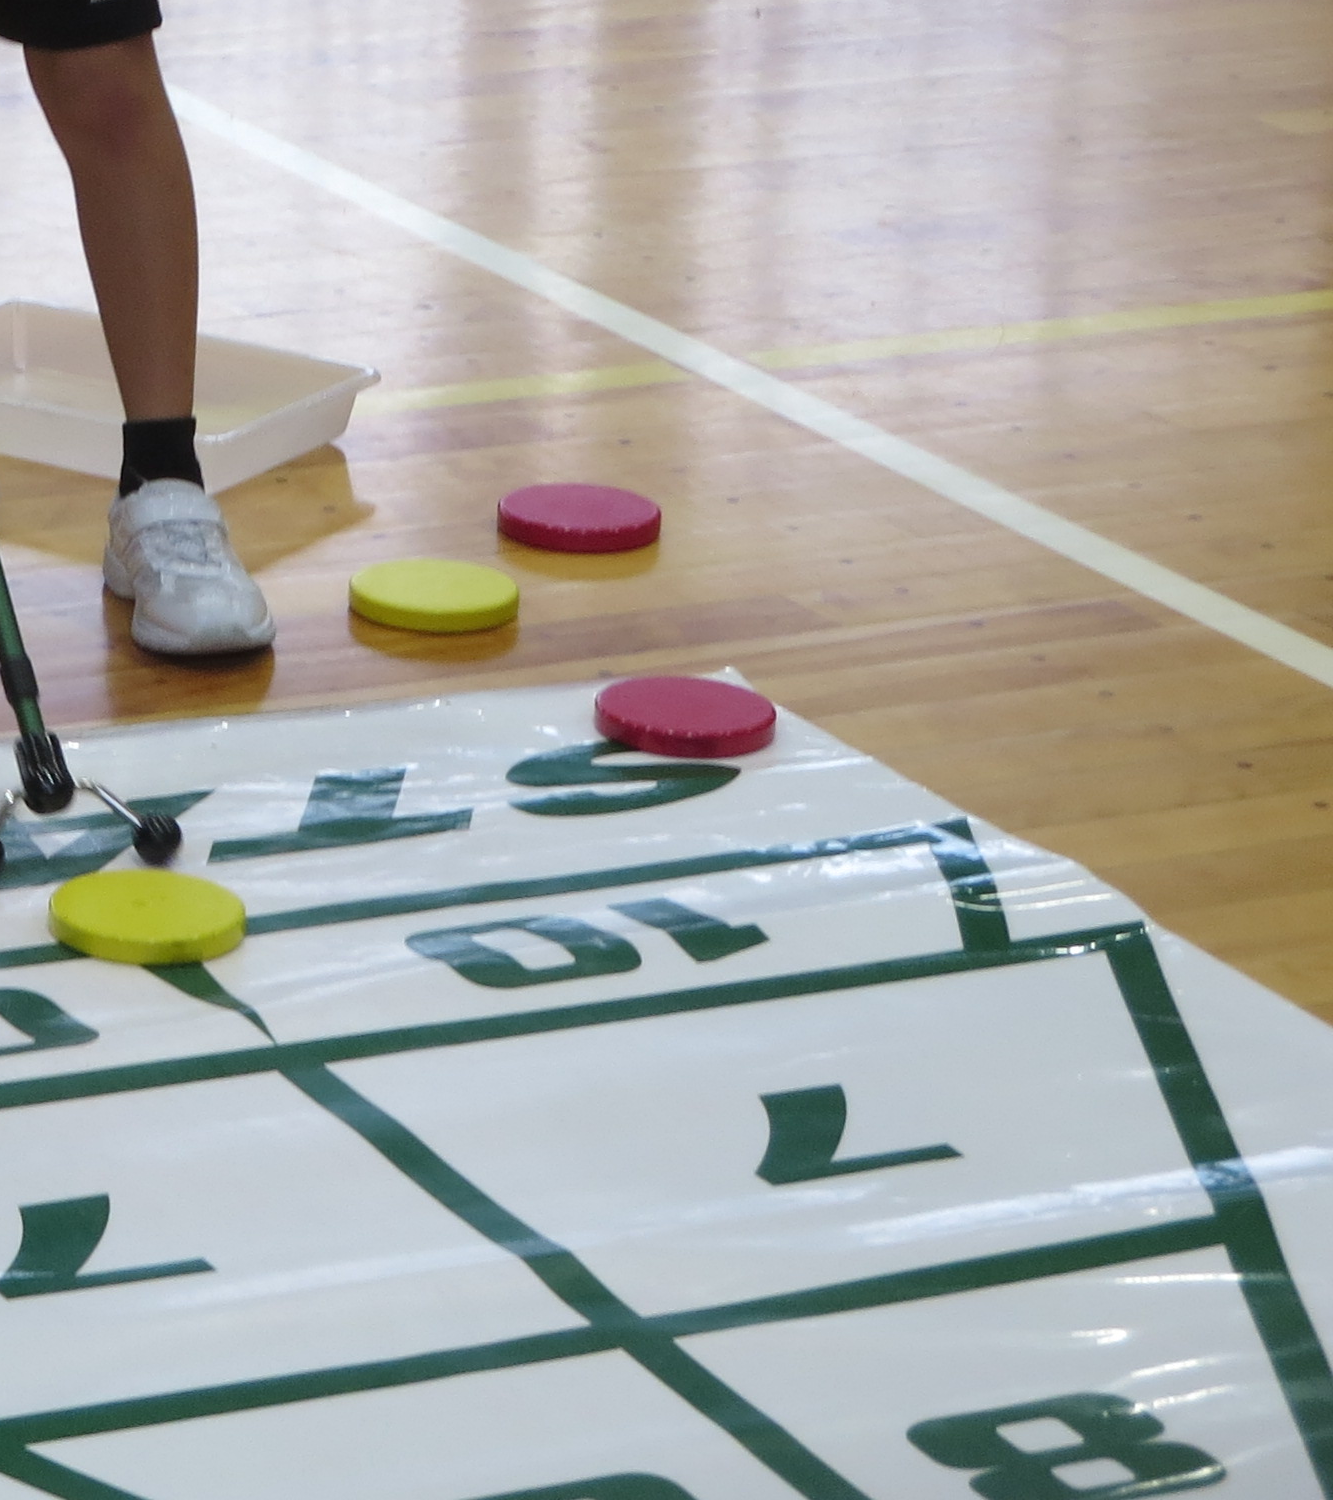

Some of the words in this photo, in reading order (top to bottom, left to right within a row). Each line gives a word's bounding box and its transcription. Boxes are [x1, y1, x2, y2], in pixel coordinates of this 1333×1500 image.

[405, 897, 769, 989] 10
[755, 1083, 964, 1187] 7
[905, 1390, 1227, 1500] 8
